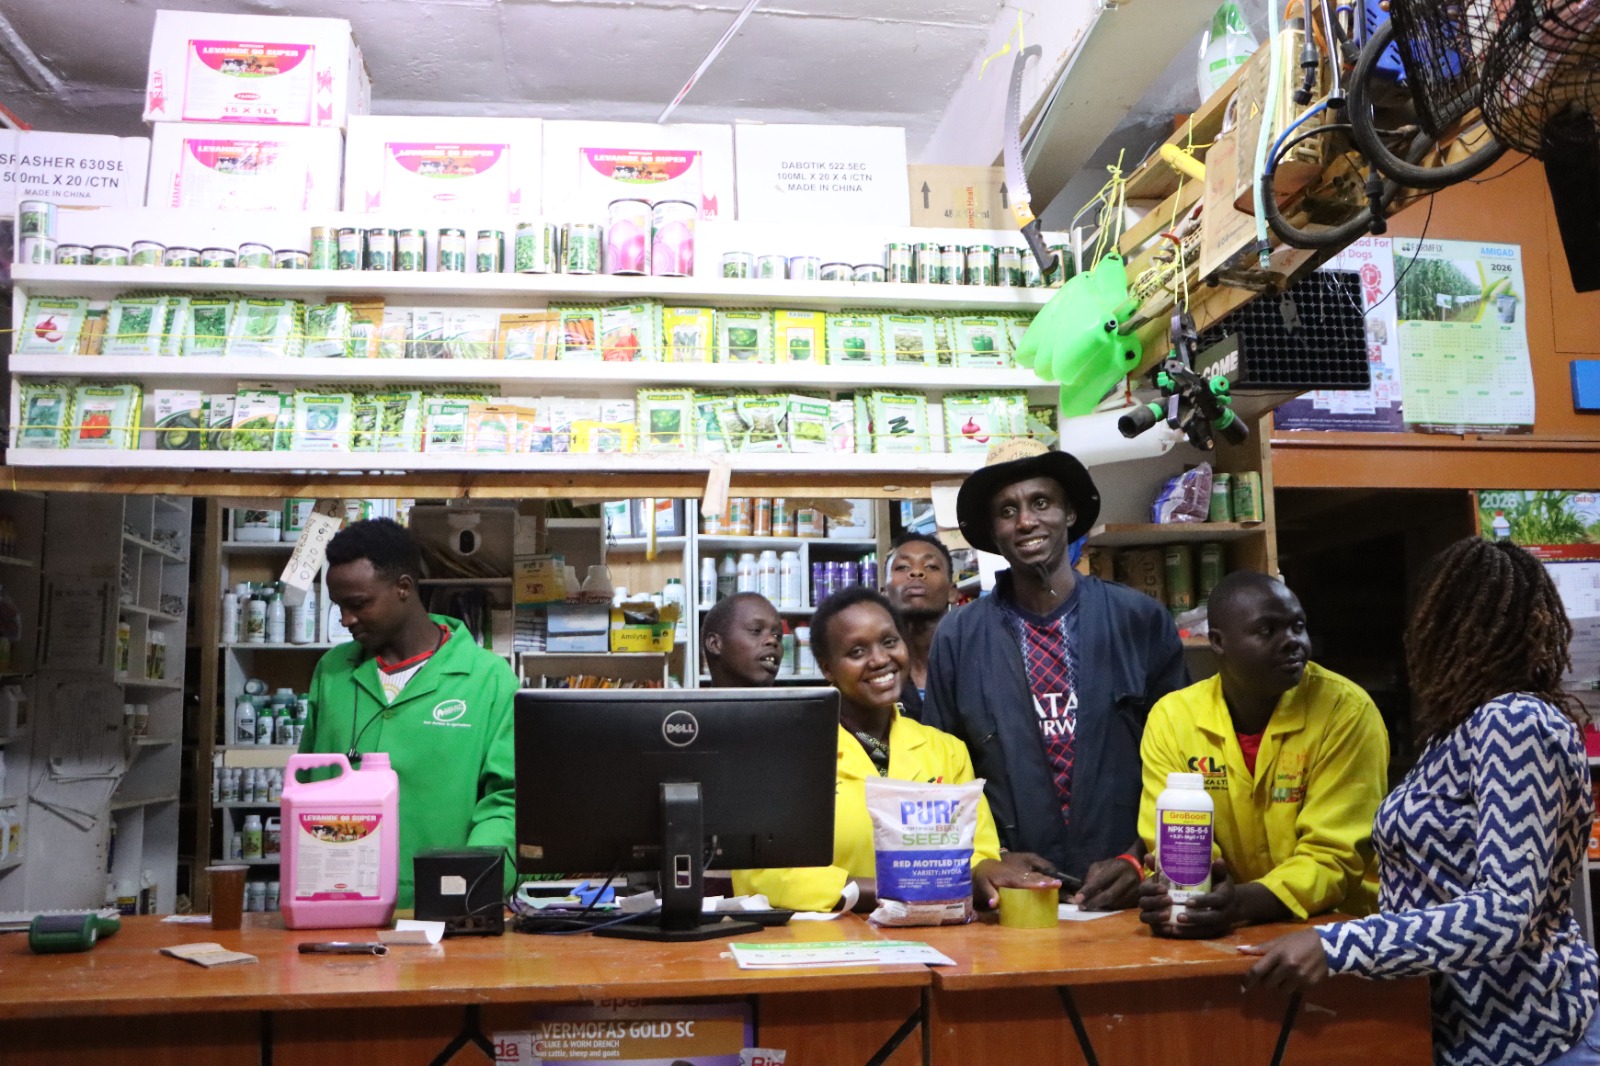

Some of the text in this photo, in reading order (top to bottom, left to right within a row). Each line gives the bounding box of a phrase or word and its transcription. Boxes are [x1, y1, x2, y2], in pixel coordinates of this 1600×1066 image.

[781, 162, 866, 170] DABOTIK 522.5EC
[53, 174, 62, 186] X
[66, 176, 82, 186] 20
[85, 176, 120, 188] /CTN
[24, 188, 91, 198] MADE IN CHINA
[832, 184, 863, 192] CHINA
[1352, 238, 1390, 248] ood For
[1348, 249, 1373, 260] Dogs
[1480, 247, 1514, 257] AMIGAD
[1490, 264, 1512, 272] 2026
[1481, 492, 1518, 508] 2026
[666, 724, 694, 734] DELL
[1170, 812, 1208, 820] GroBoost
[1168, 826, 1184, 834] NPK
[902, 833, 960, 846] SEEDS
[893, 860, 912, 868] RED
[913, 859, 952, 868] MOTTLED
[541, 1020, 694, 1040] VERMOFAS GOLD SC
[593, 1040, 620, 1048] DRENCH
[548, 1050, 568, 1058] cattle,
[570, 1050, 588, 1058] sheep
[602, 1050, 620, 1058] goats
